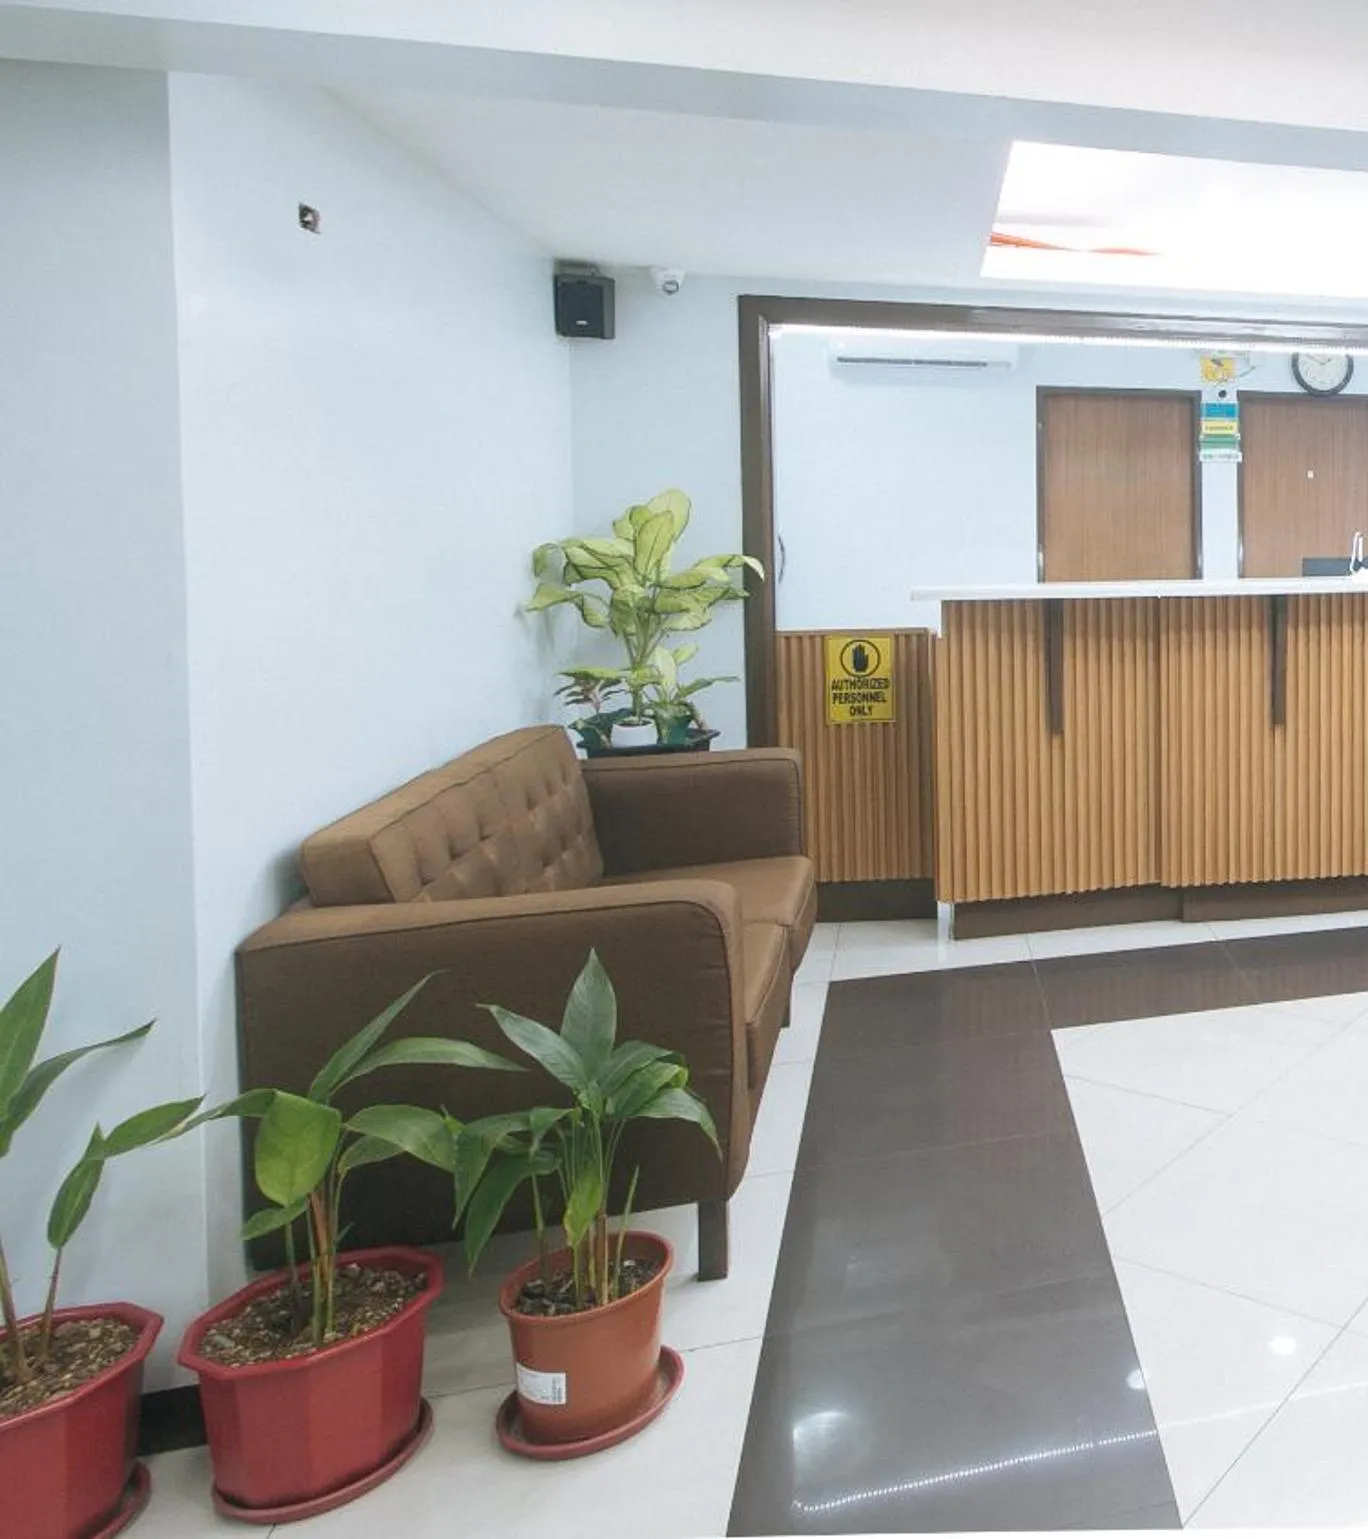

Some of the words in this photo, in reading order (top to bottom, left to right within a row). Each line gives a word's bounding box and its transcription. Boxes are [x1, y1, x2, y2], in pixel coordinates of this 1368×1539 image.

[832, 678, 890, 690] AUTHORIZED
[832, 691, 887, 704] PERSONNEL
[849, 705, 873, 716] ONLY
